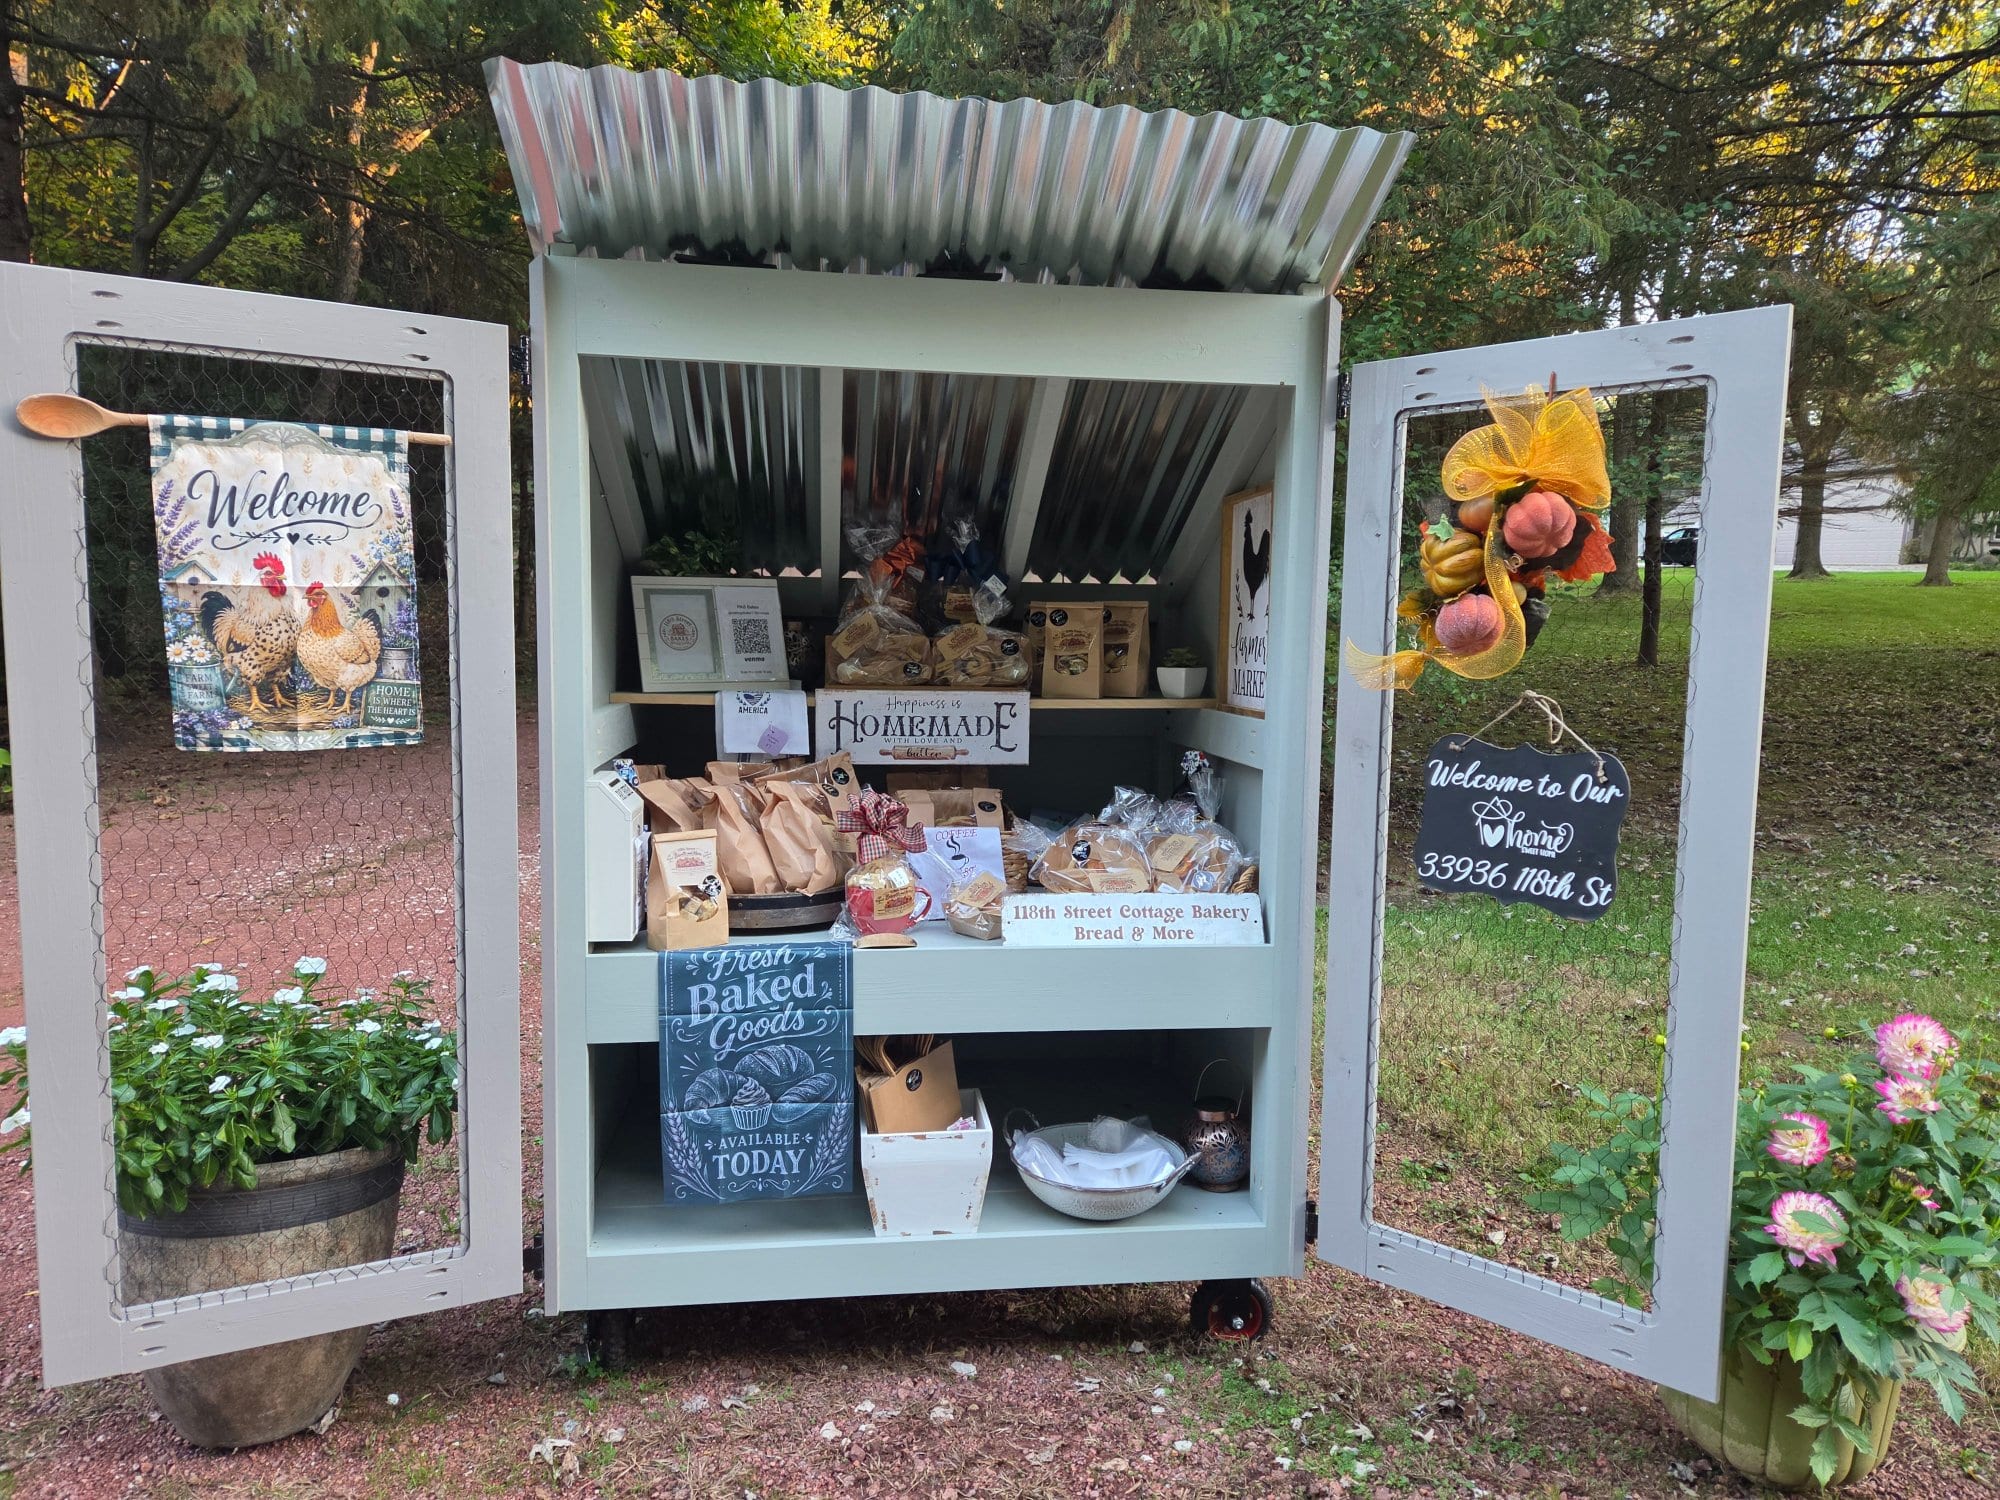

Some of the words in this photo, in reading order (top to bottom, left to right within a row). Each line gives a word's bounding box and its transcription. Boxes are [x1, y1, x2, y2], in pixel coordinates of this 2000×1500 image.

[187, 469, 382, 530] Welcome
[1231, 622, 1268, 666] farmer
[376, 685, 411, 697] HOME
[1232, 668, 1267, 698] MARKE
[383, 697, 411, 706] WHERE
[383, 707, 408, 715] HEART
[886, 696, 946, 713] Happiness
[951, 700, 962, 709] is
[829, 700, 1018, 755] HOMEMADE
[907, 747, 942, 758] butter
[1429, 759, 1534, 793] Welcome
[1537, 774, 1566, 799] to
[1570, 773, 1624, 804] Our
[935, 829, 978, 841] COFFEE
[1506, 811, 1575, 853] home
[1418, 852, 1509, 889] 33936
[1513, 867, 1575, 900] 118th
[1578, 876, 1612, 907] St
[1013, 905, 1056, 920] 118th
[1063, 905, 1112, 919] Street
[1119, 904, 1184, 923] Cottage
[1192, 904, 1250, 921] Bakery
[1074, 926, 1124, 940] Bread
[1131, 927, 1144, 941] &
[1152, 926, 1195, 940] More
[702, 945, 796, 982] Fresh
[687, 963, 816, 1028] Baked
[709, 1002, 805, 1061] Goods
[719, 1133, 800, 1149] AVAILABLE
[712, 1149, 806, 1179] TODAY
